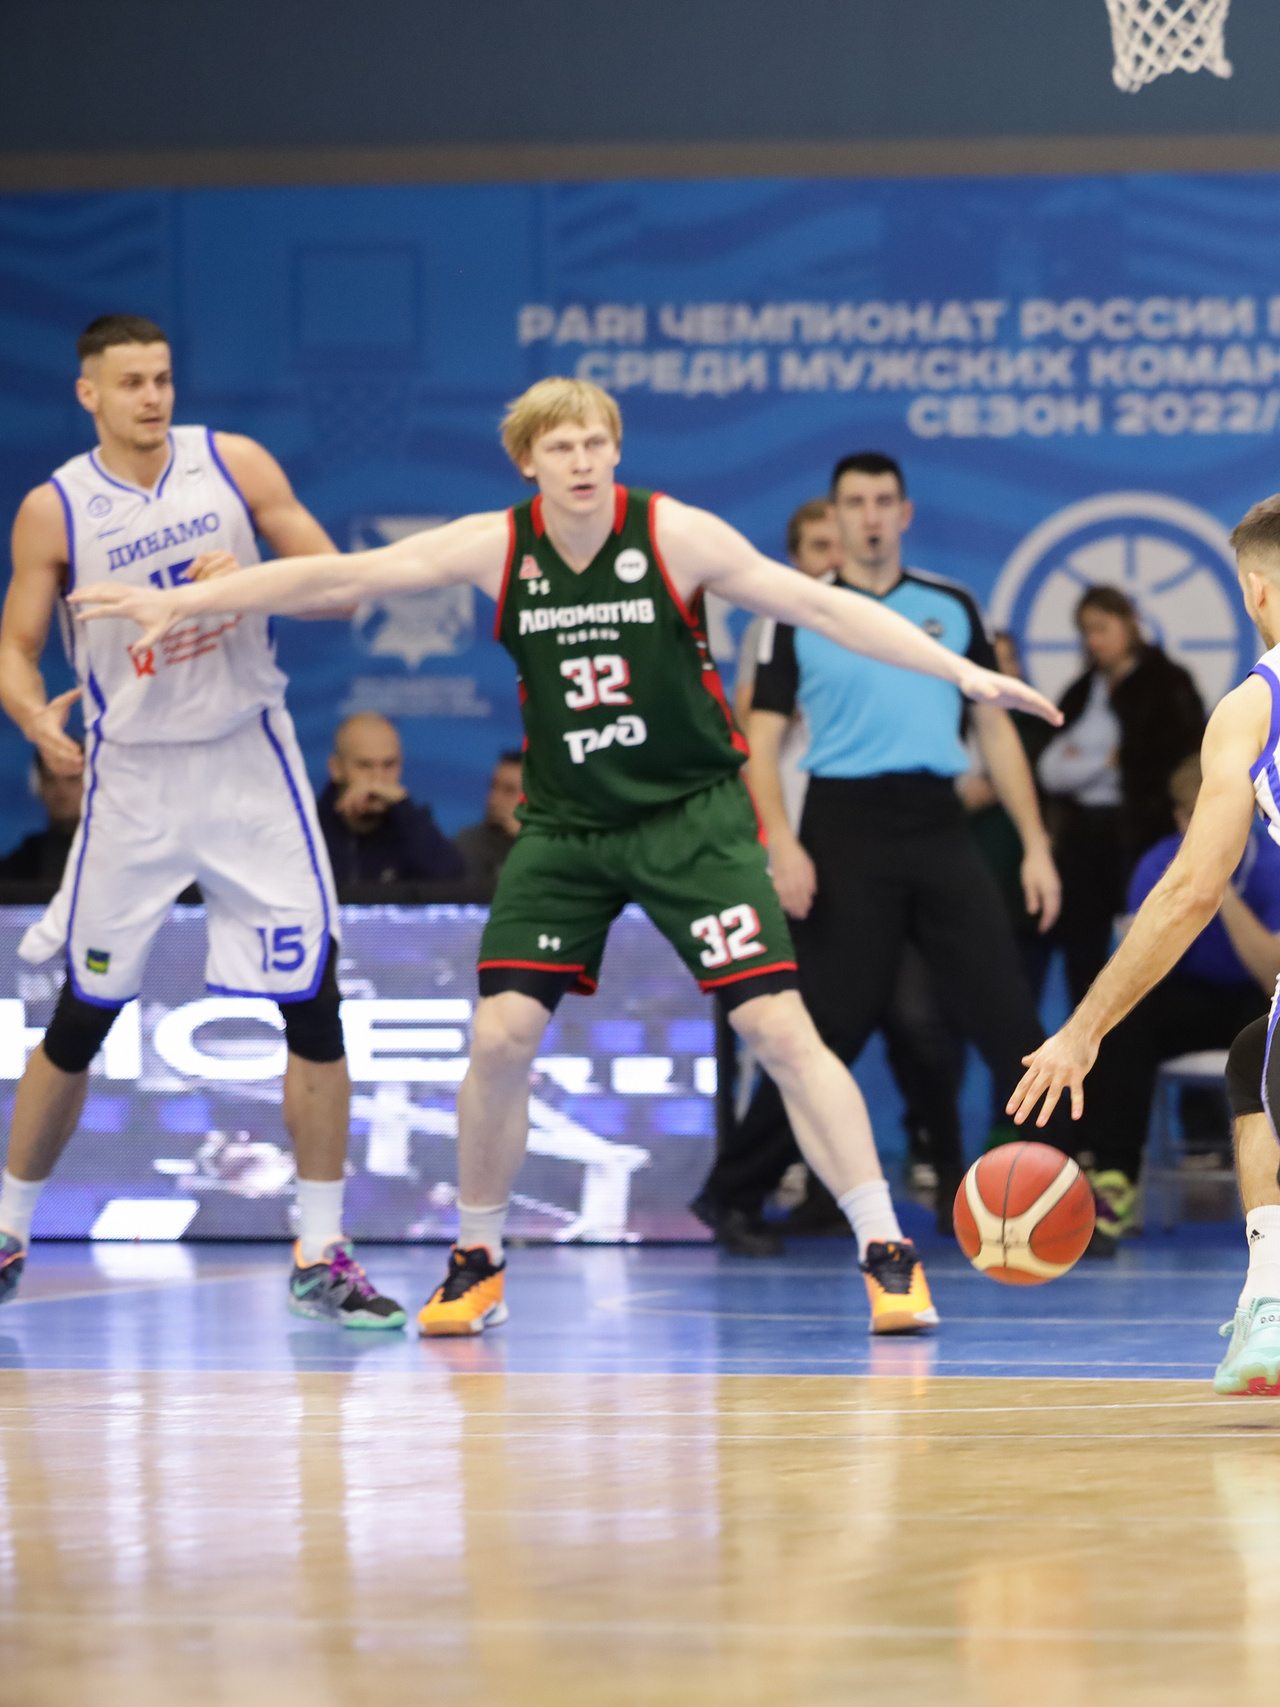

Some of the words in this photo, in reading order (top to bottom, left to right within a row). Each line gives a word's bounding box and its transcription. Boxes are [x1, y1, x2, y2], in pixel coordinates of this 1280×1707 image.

[517, 303, 646, 345] PARI
[659, 301, 1005, 344] ЧЕМПИОНАТ
[1019, 298, 1256, 341] РОССИИ
[576, 351, 767, 395] СРЕДИ
[780, 350, 1076, 391] МУЖСКИХ
[907, 396, 1101, 438] СЕЗОН
[106, 512, 221, 572] ДИНАМО
[519, 598, 656, 636] ЛОКОМОТИВ
[557, 627, 621, 645] КУБАНЬ
[560, 654, 634, 712] 32
[256, 925, 305, 973] 15
[690, 903, 767, 969] 32
